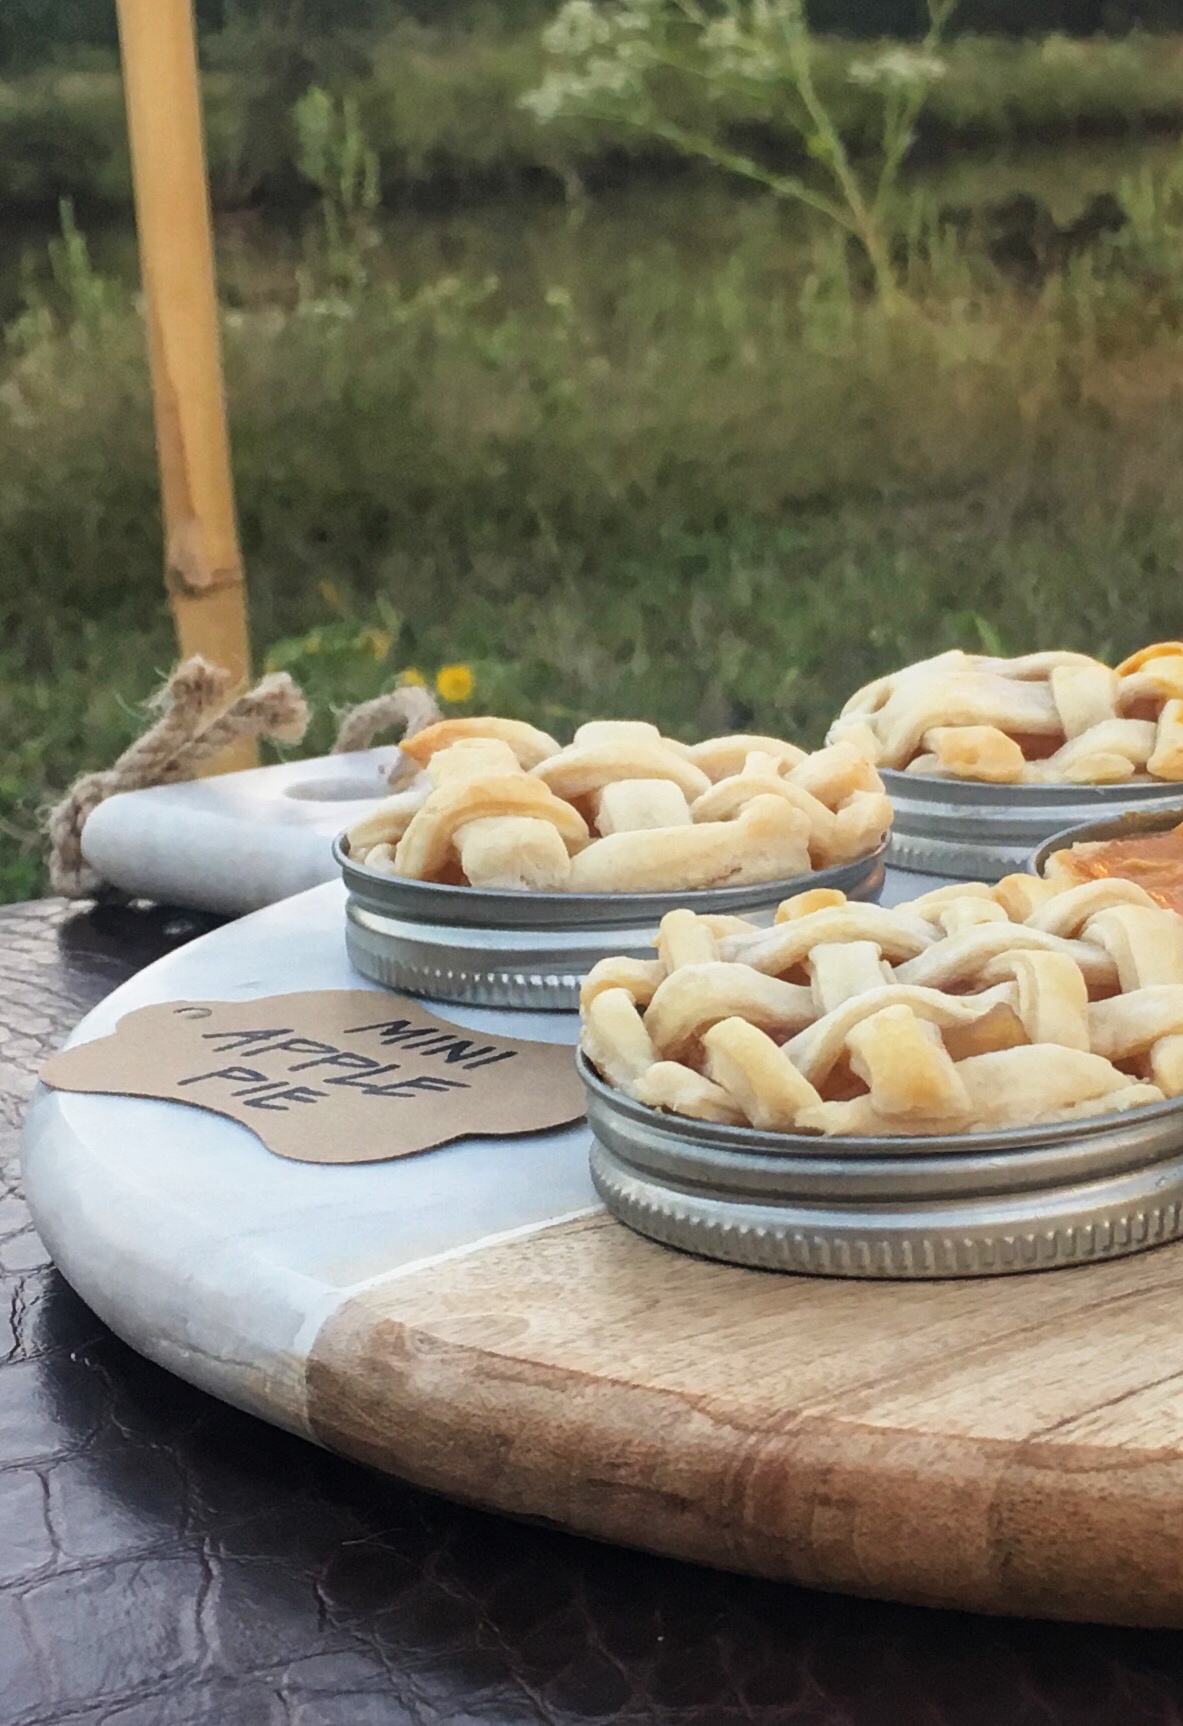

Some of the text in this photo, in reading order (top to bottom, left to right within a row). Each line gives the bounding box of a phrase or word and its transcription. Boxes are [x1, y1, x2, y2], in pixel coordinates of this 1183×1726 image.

[202, 1028, 472, 1098] APPLE
[343, 1019, 518, 1070] MINI
[176, 1066, 330, 1111] PIE
